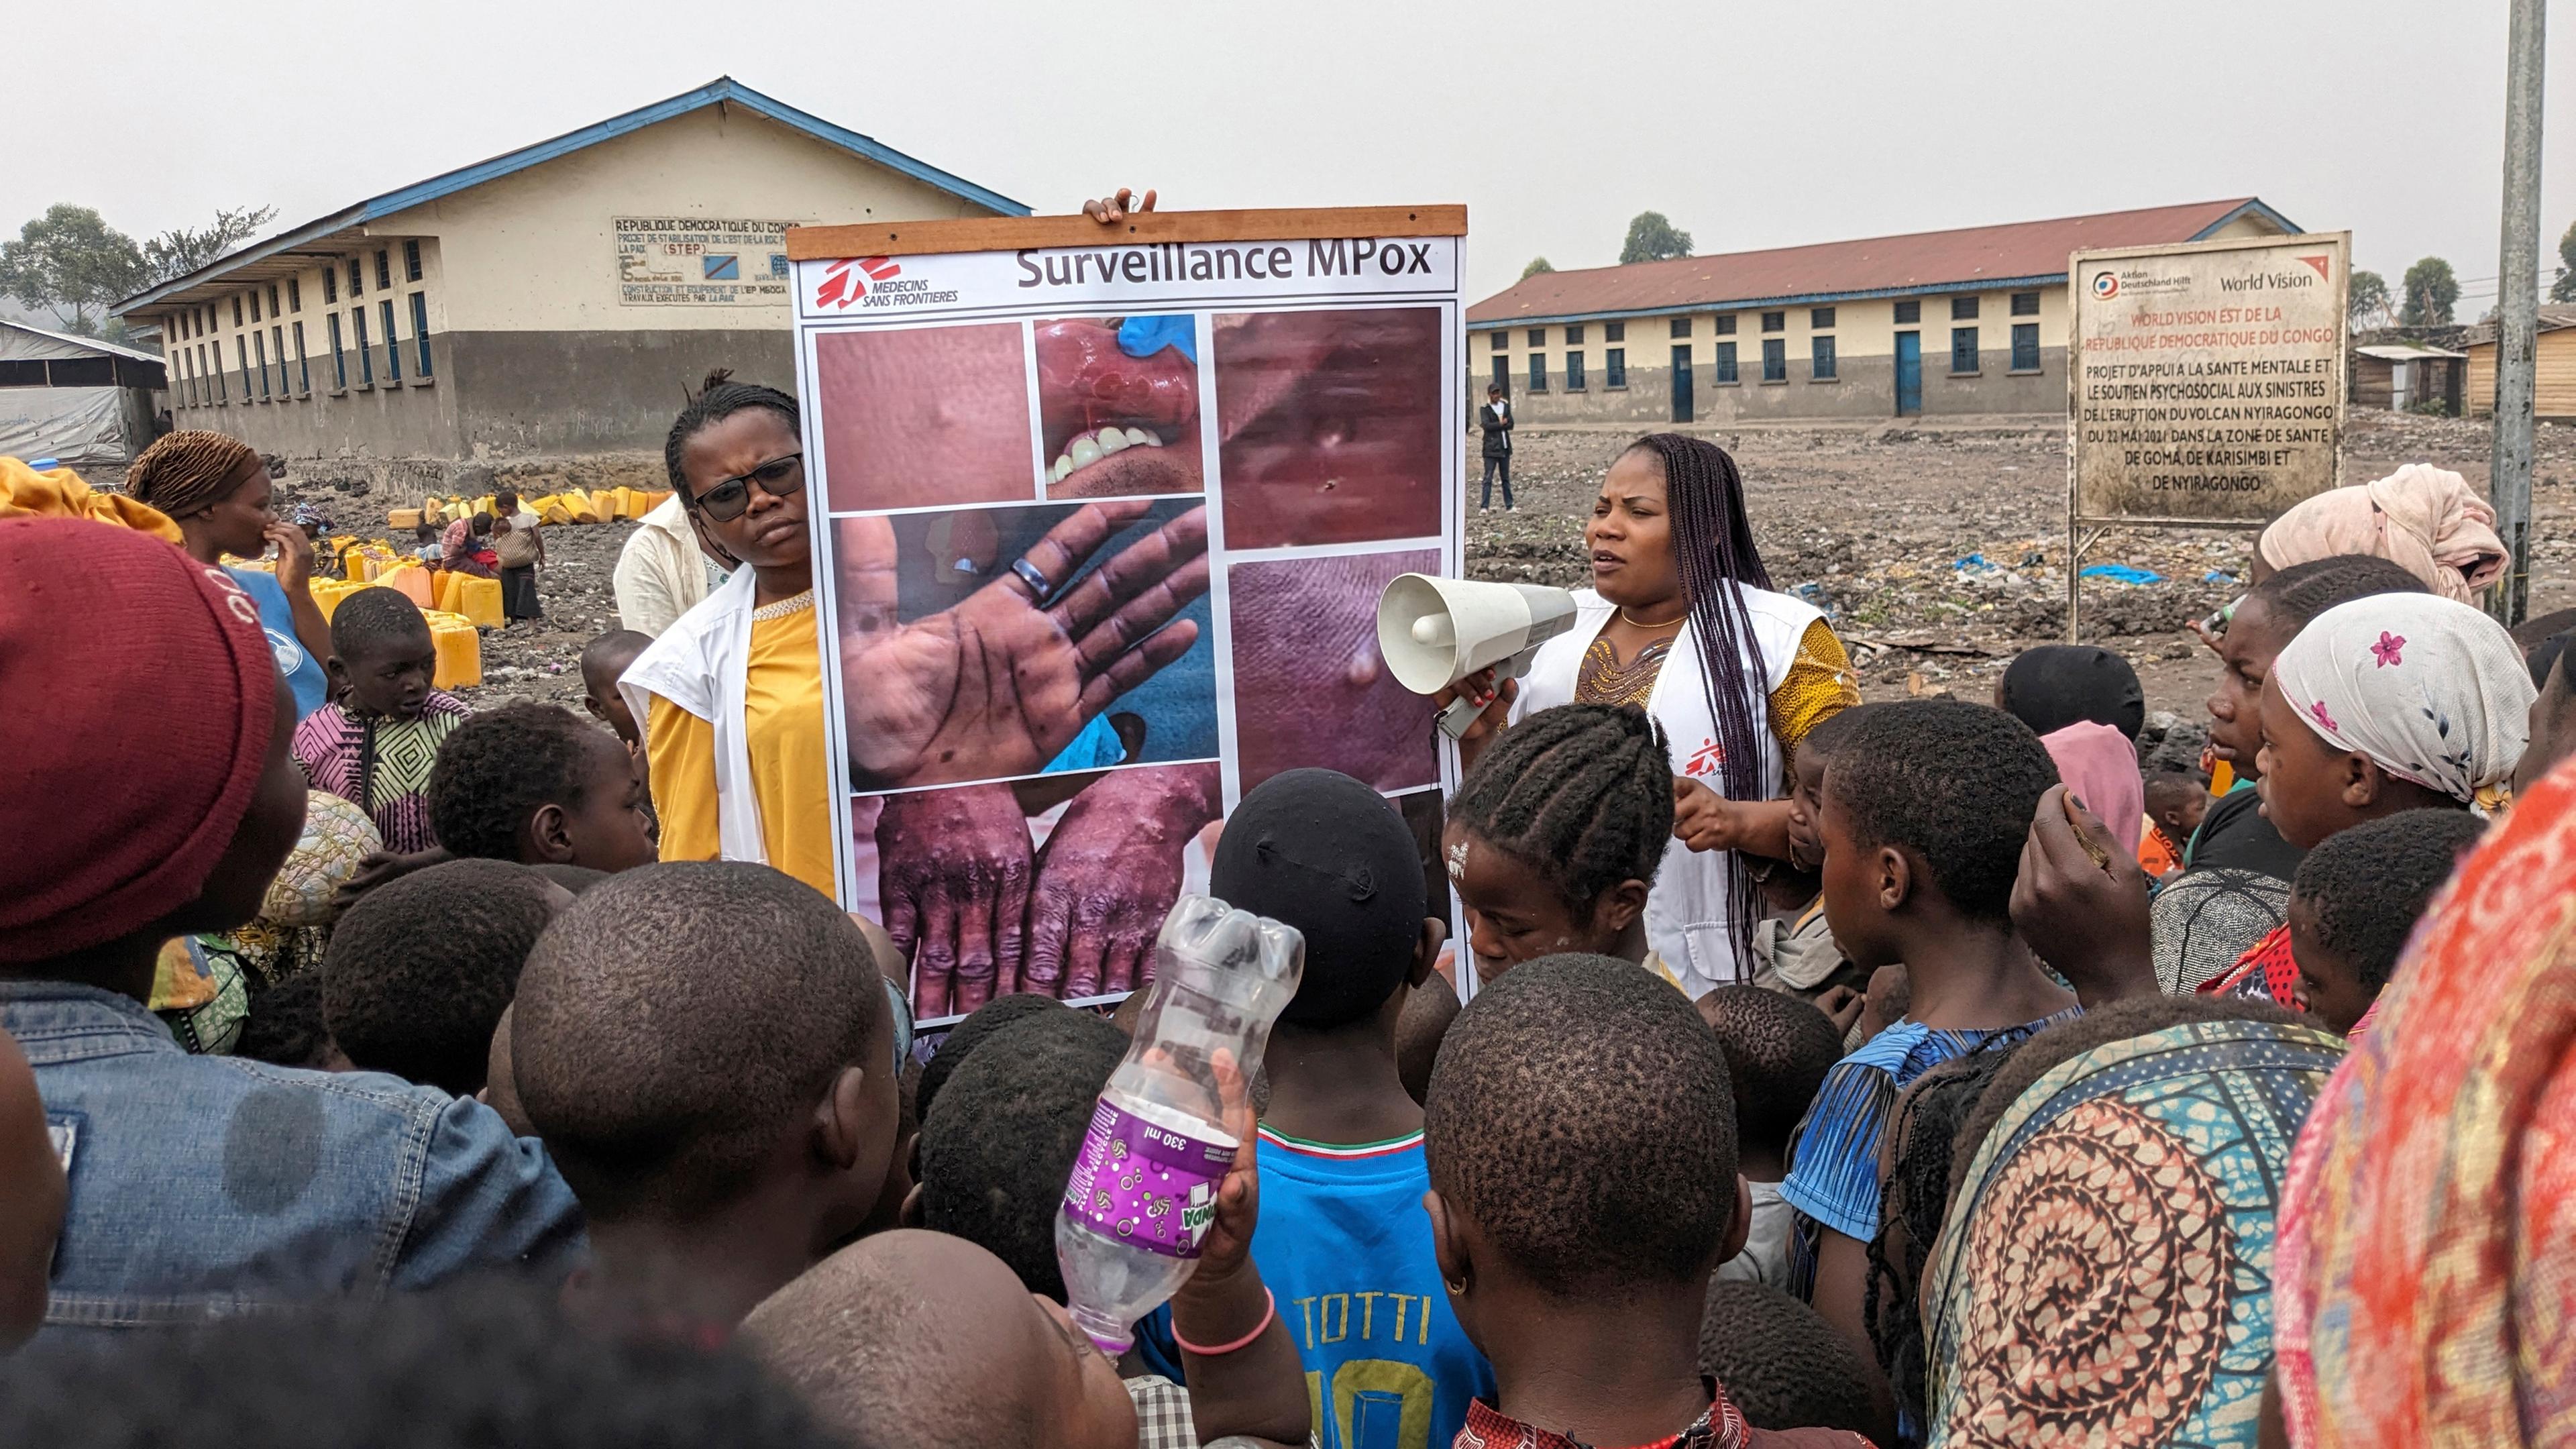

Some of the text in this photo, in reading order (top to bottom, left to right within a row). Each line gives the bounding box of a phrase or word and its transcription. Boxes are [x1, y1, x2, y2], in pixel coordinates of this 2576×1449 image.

[616, 220, 676, 231] REPUBLIQUE
[679, 221, 749, 232] DEMOCRATIQUE
[752, 222, 765, 233] DU
[618, 234, 645, 242] PROJET
[647, 234, 657, 242] DE
[659, 234, 708, 243] STABILISATION
[712, 235, 720, 244] DE
[619, 245, 629, 254] LA
[664, 244, 706, 255] (STEP)
[1018, 237, 1434, 288] Surveillance MPox
[623, 285, 672, 294] CONSTRUCTION
[676, 285, 684, 294] ET
[730, 286, 739, 295] DE
[872, 280, 928, 294] MEDECINS
[2121, 276, 2191, 288] Deutschland Hilft
[2220, 271, 2312, 292] World Vision
[624, 294, 654, 303] TRAVAUX
[657, 294, 690, 303] EXECUTES
[694, 294, 706, 303] PAR
[863, 290, 959, 307] SANS FRONTIERES
[2131, 307, 2282, 327] WORLD VISION EST DE LA
[2086, 329, 2333, 351] REPUBLIQUE DEMOCRATIQUE DU CONGO
[2087, 359, 2332, 381] PROJET D'APPUI A LA SANTE MENTALE ET
[2088, 381, 2326, 400] LE SOUTIEN PSYCHOSOCIAL AUX SINISTRES
[2084, 405, 2333, 422] DE L'ERUPTION DU VOLCAN NYIRAGONGO
[2088, 428, 2328, 443] DU 22 MAI 2021 DANS LA ZONE DE SANTE
[2125, 450, 2291, 468] DE GOMA, DE KARISIMBI ET
[2153, 476, 2261, 491] DE NYIRAGONGO
[1144, 1126, 1187, 1150] 330 ml
[1078, 1112, 1119, 1212] PLEASE RECYCLE ME
[1293, 1291, 1432, 1350] TOTTI
